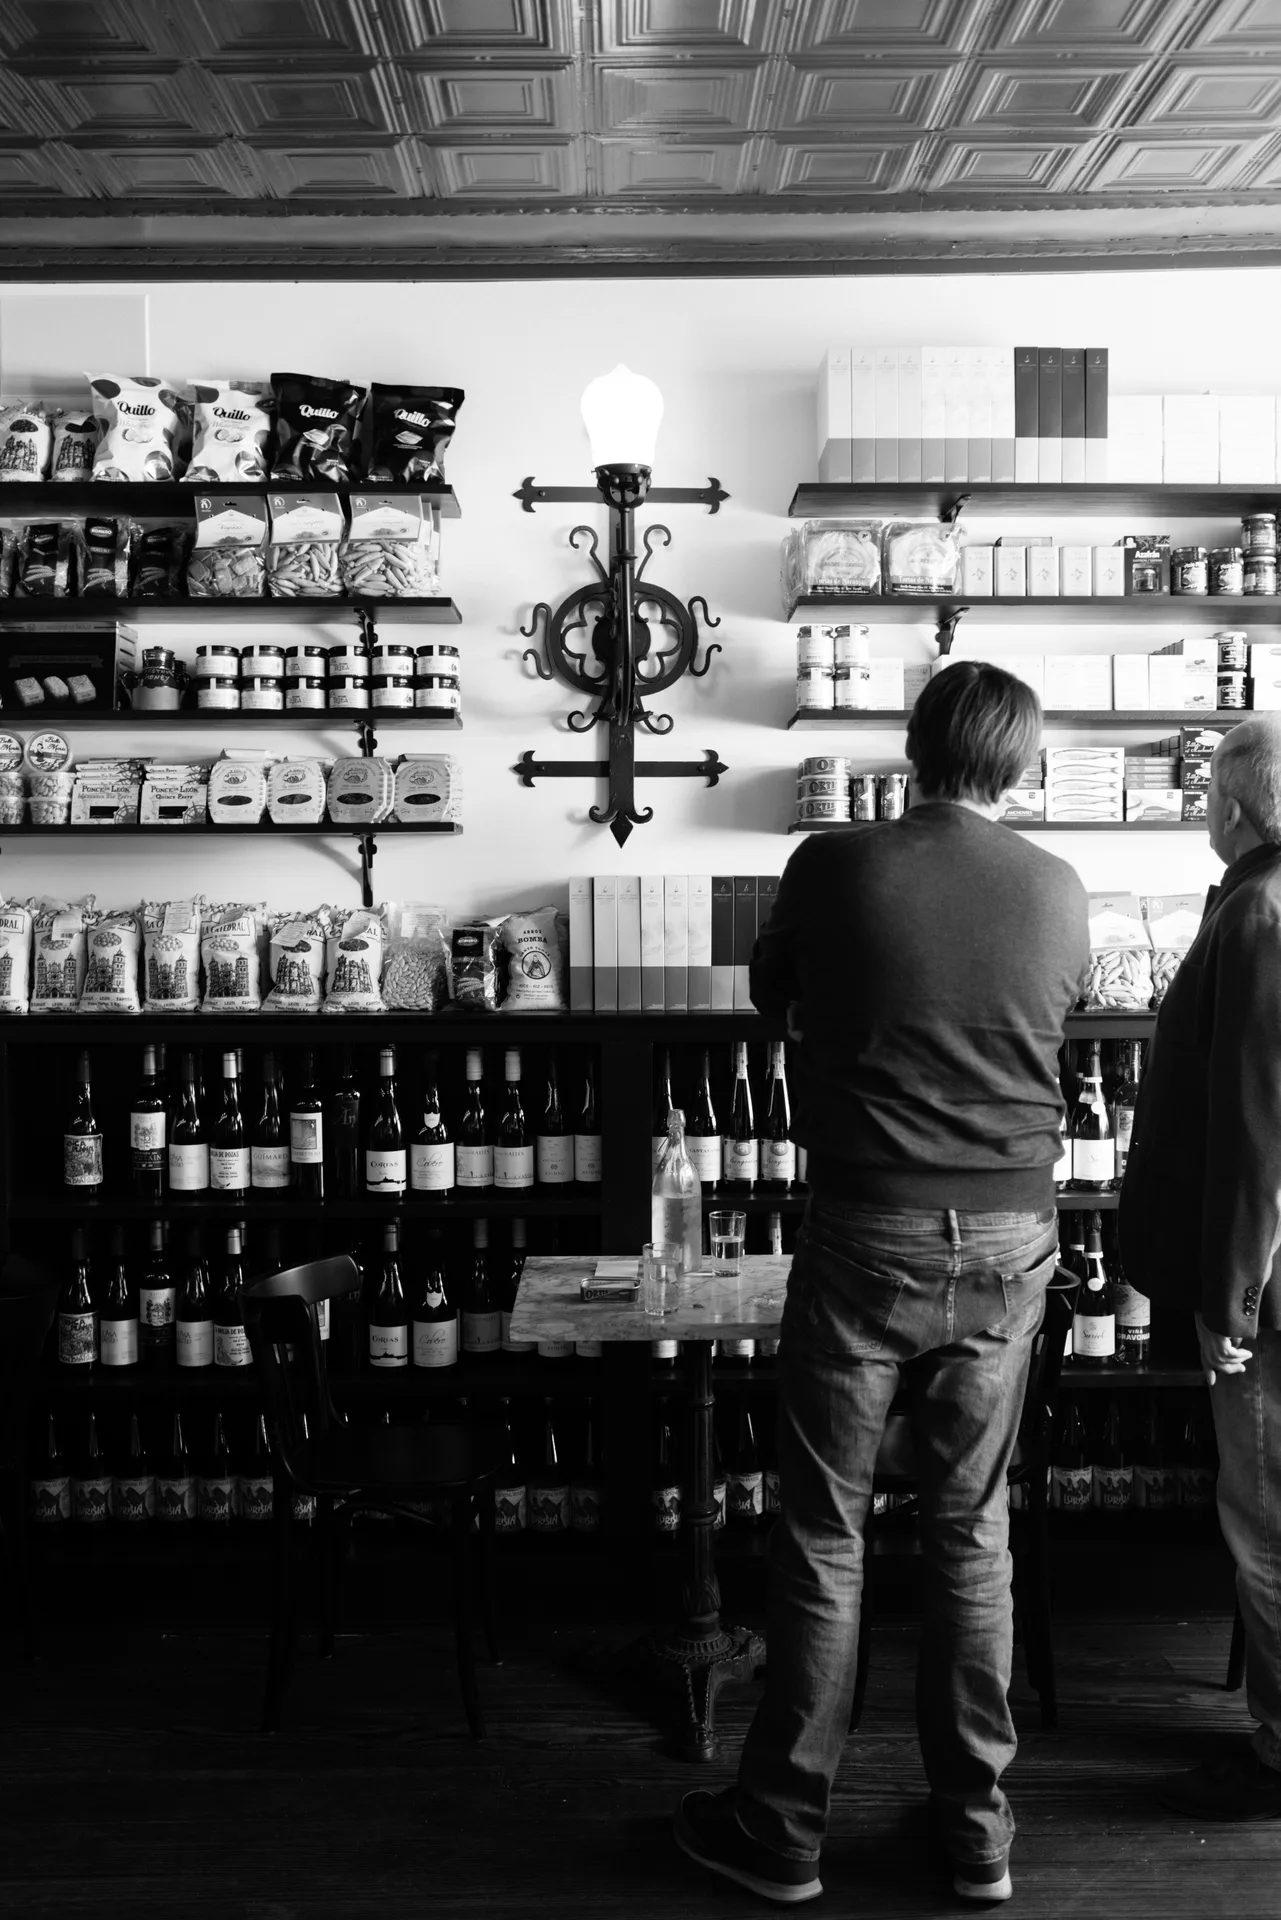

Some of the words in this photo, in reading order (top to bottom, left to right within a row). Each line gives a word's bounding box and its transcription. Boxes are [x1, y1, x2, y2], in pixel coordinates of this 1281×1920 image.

[117, 400, 156, 416] Quillo
[212, 406, 251, 421] Quillo
[299, 404, 339, 420] Quillo
[394, 408, 431, 428] Quillo
[809, 781, 835, 793] ORTI
[210, 921, 245, 933] CATEDRAL
[517, 936, 548, 944] BOMBA
[370, 1160, 399, 1168] CORIAS
[371, 1334, 399, 1343] CORIAS
